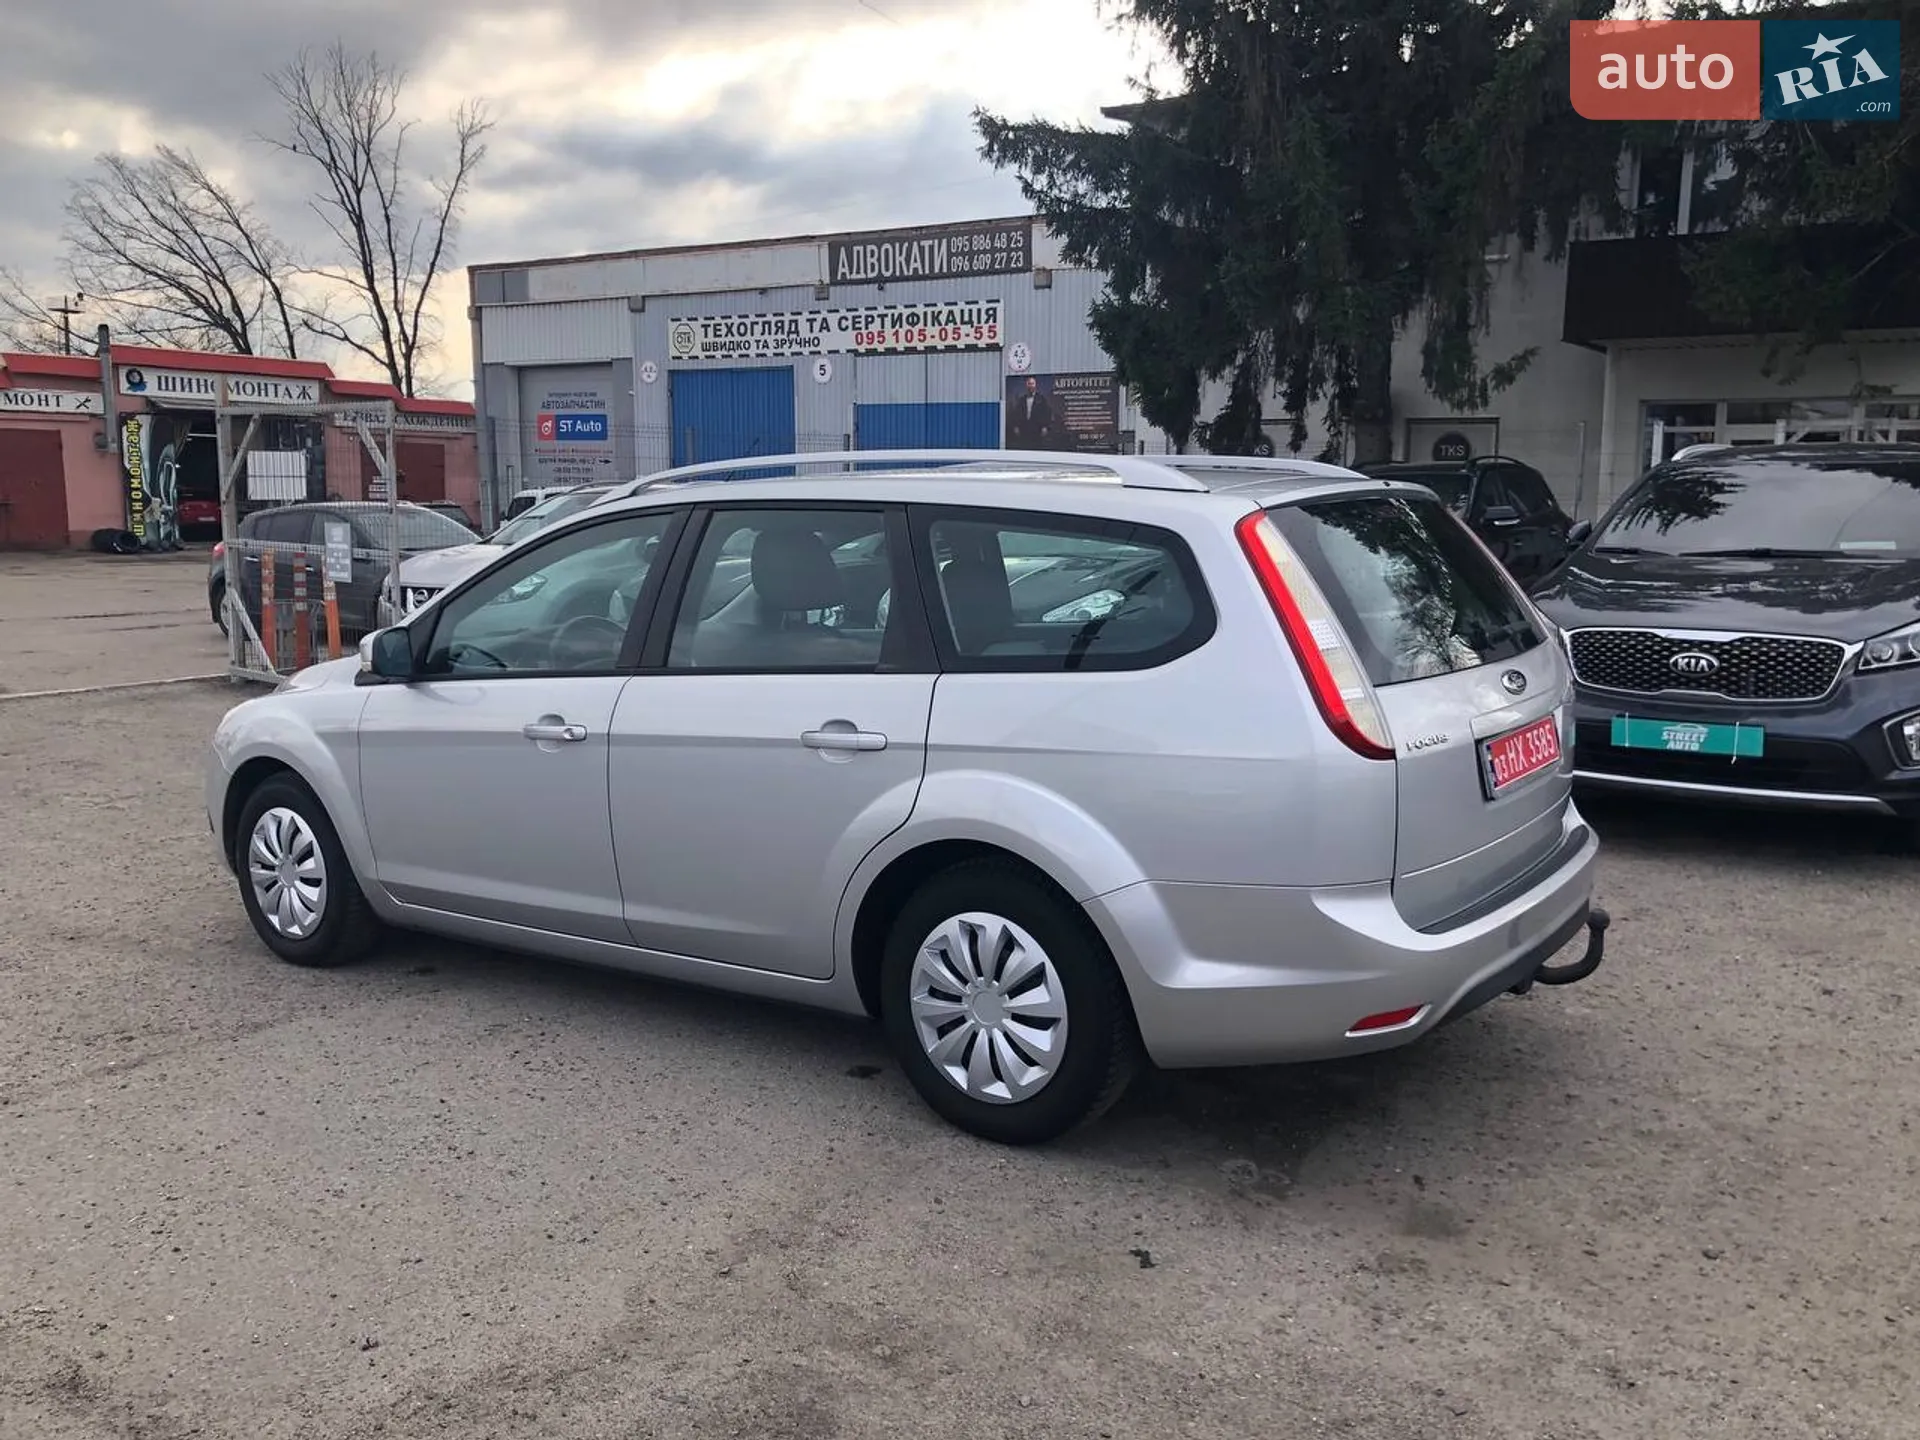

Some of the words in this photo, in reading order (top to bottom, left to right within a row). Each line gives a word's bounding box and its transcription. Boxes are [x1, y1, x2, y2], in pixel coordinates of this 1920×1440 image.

[951, 236, 969, 253] 095
[972, 235, 991, 251] 886
[994, 233, 1008, 249] 48
[1010, 231, 1024, 248] 25
[837, 238, 948, 281] АДВОКАТИ
[951, 256, 969, 272] 096
[972, 254, 991, 270] 609
[995, 253, 1007, 269] 27
[1010, 252, 1024, 267] 23
[701, 319, 800, 338] ТЕХОГЛЯД
[806, 317, 831, 333] ТА
[837, 307, 998, 332] СЕРТИФІКАЦІЯ
[855, 330, 886, 346] 095
[893, 325, 998, 344] 105-05-55
[701, 340, 750, 352] ШВИДКО
[755, 339, 769, 350] ТА
[773, 337, 821, 350] ЗРУЧНО
[819, 365, 827, 376] 5
[559, 420, 573, 432] ST
[575, 420, 602, 432] Auto
[1440, 445, 1465, 456] TKS
[1677, 658, 1709, 672] KIA
[1494, 755, 1509, 781] 03
[1526, 723, 1556, 765] 3585
[1666, 740, 1700, 751] AUTO
